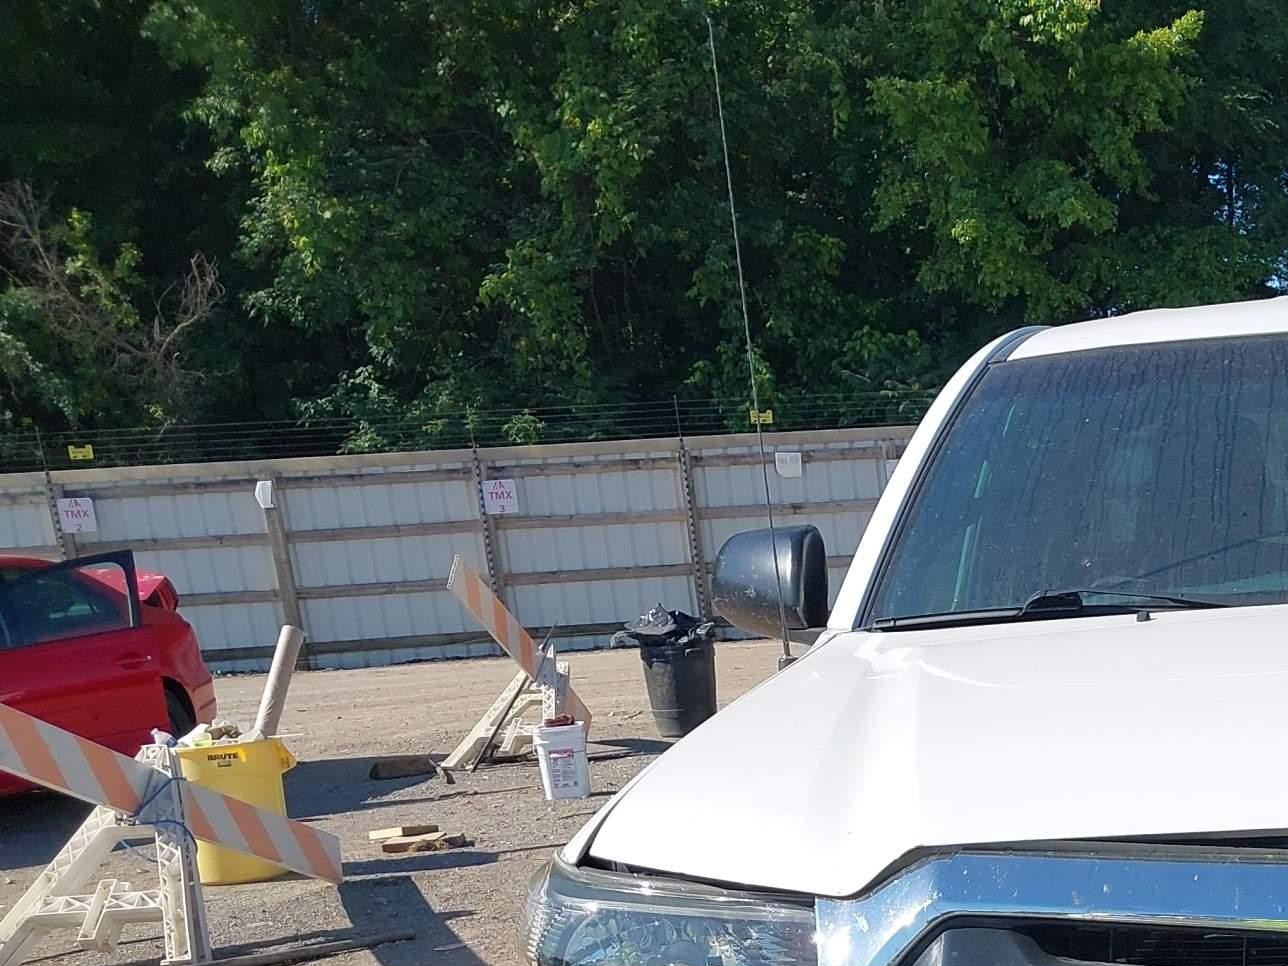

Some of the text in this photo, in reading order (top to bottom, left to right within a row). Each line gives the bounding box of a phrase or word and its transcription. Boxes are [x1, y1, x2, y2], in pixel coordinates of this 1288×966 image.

[488, 490, 513, 500] TMX
[499, 504, 505, 513] 3
[63, 510, 90, 520] TMX
[75, 523, 82, 532] 2
[207, 752, 239, 761] BRUTE
